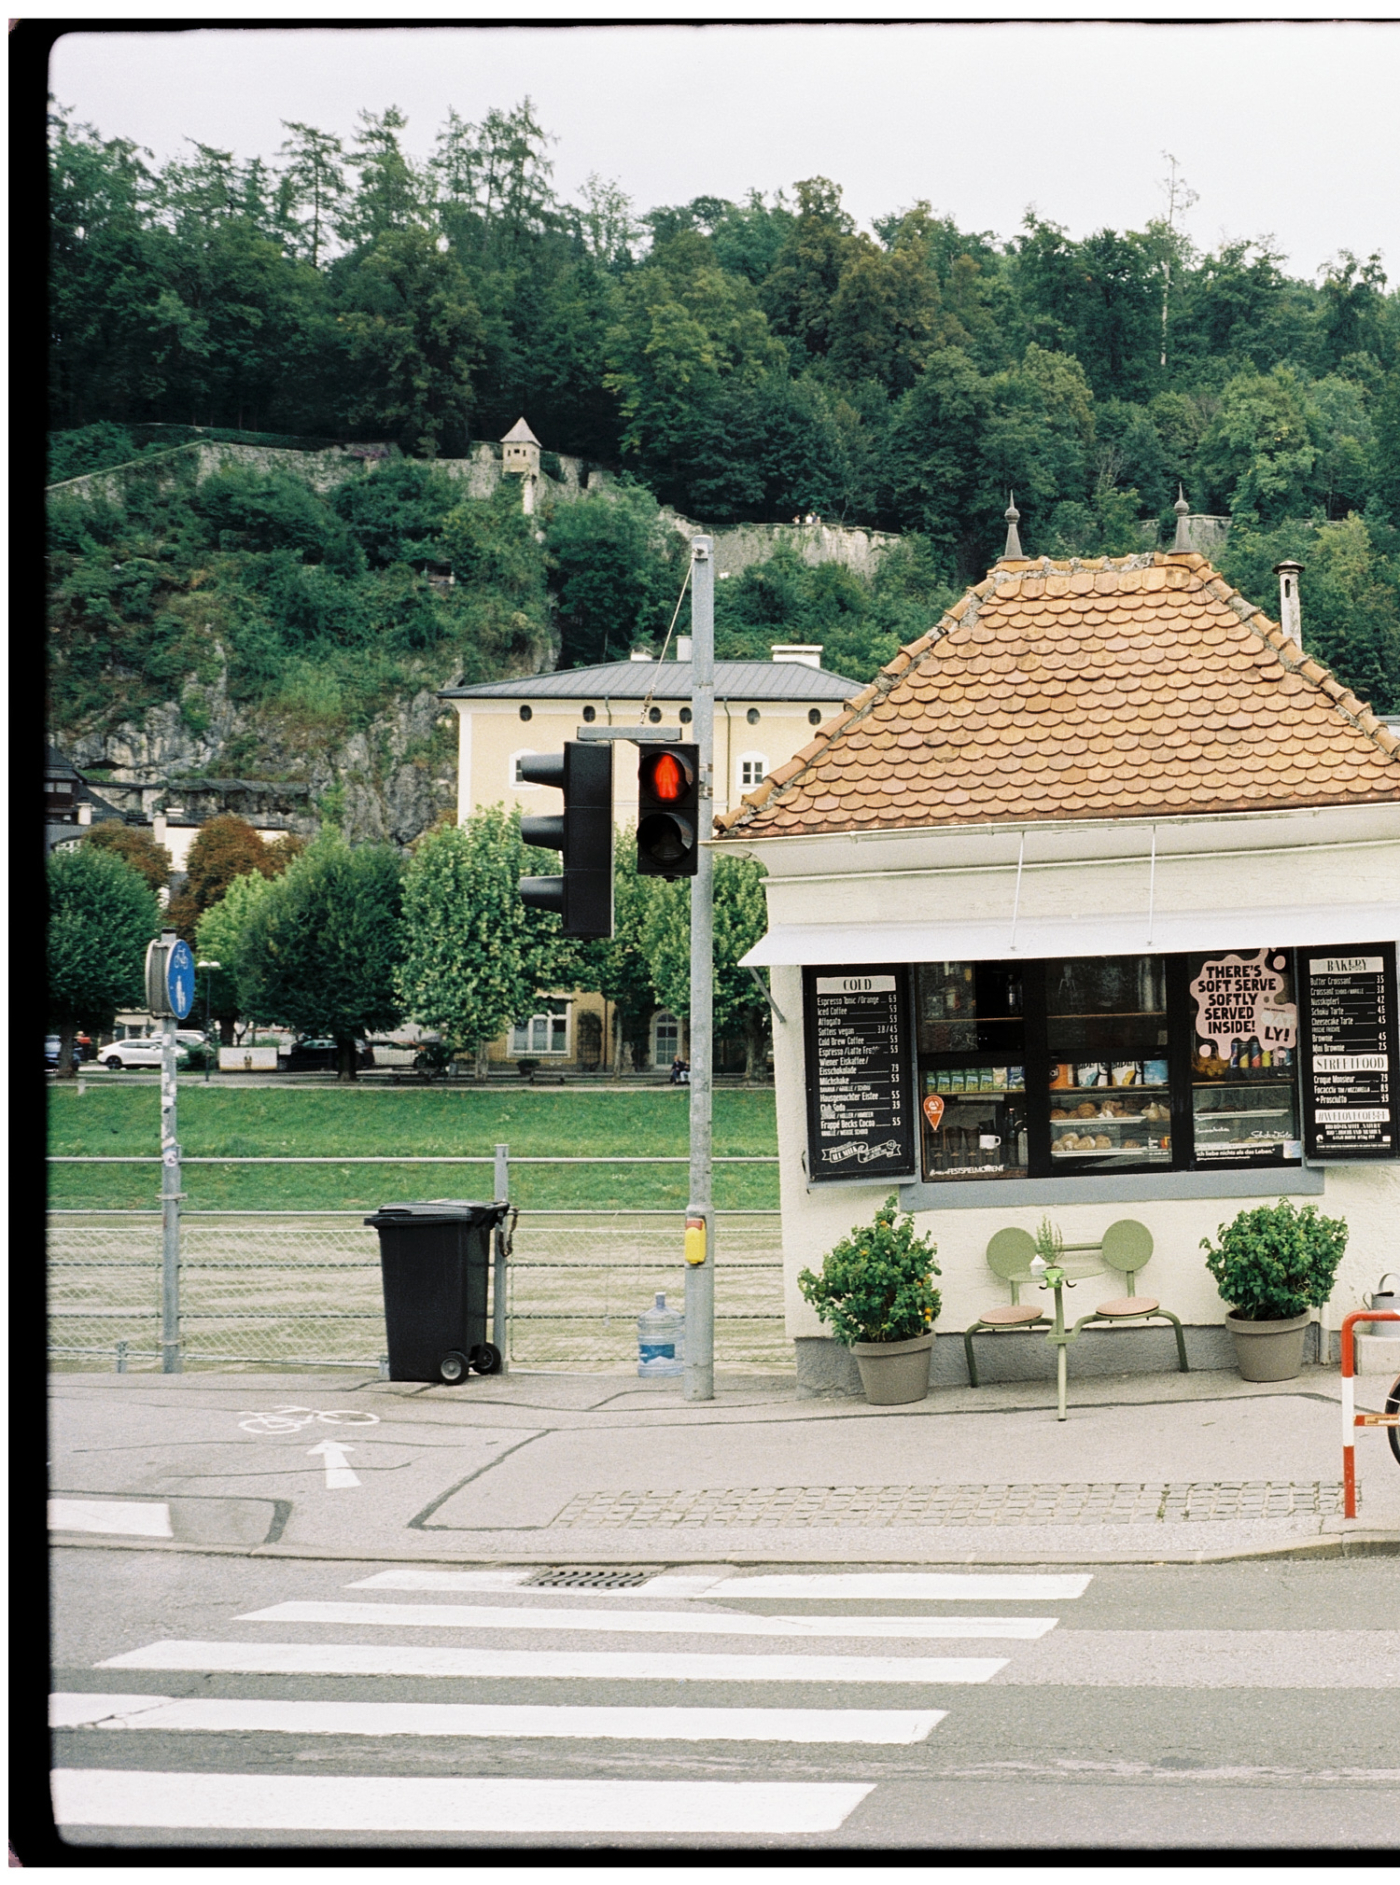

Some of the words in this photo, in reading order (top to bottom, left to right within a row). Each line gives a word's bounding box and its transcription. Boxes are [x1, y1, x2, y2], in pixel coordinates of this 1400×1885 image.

[1206, 965, 1262, 978] THERE'S
[1327, 959, 1367, 972] BAKERY
[843, 978, 872, 991] COLD
[1198, 980, 1231, 993] SOFT
[1235, 978, 1276, 992] SERVE
[817, 997, 842, 1007] Espresso
[1209, 993, 1258, 1006] SOFTLY
[830, 1006, 847, 1015] Coffee
[1205, 1006, 1254, 1020] SERVED
[1208, 1020, 1255, 1034] INSIDE!
[847, 1036, 864, 1045] Coffee
[1265, 1026, 1290, 1042] LY!
[818, 1047, 843, 1057] Espresso
[1316, 1057, 1384, 1070] STREETFOOD
